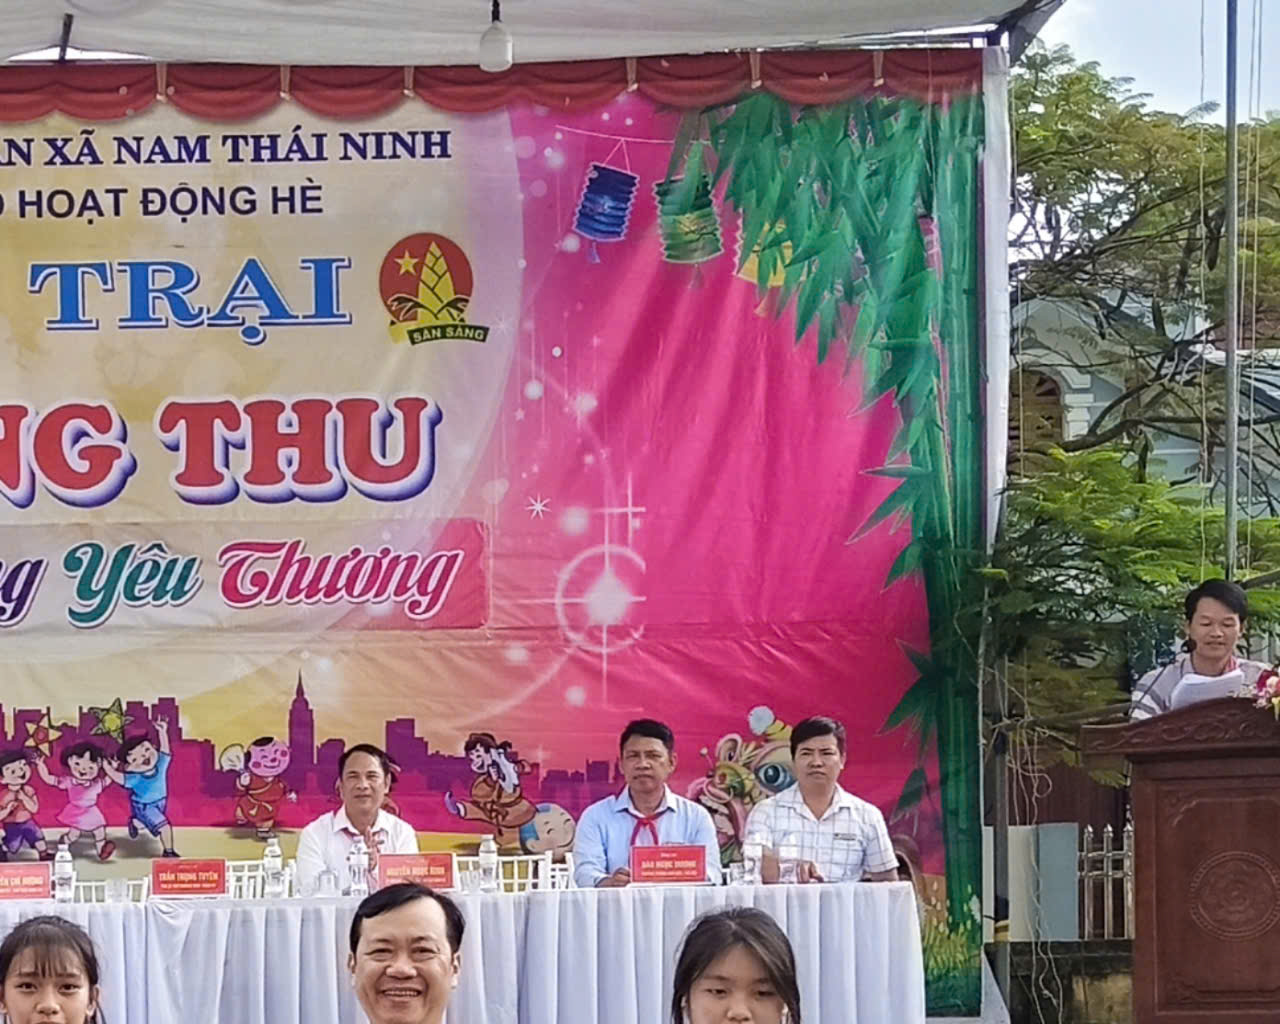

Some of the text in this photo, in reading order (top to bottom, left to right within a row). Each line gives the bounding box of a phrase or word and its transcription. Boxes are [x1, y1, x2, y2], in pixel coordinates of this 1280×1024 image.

[43, 129, 103, 166] XÃ
[113, 135, 211, 165] NAM
[222, 126, 327, 164] THÁI
[339, 130, 452, 161] NINH
[19, 188, 128, 225] HOẠT
[139, 182, 257, 223] ĐỘNG
[271, 178, 324, 215] HÈ
[28, 255, 352, 346] TRẠI
[158, 396, 444, 506] THU
[62, 541, 203, 629] Yêu
[218, 538, 465, 620] Thương
